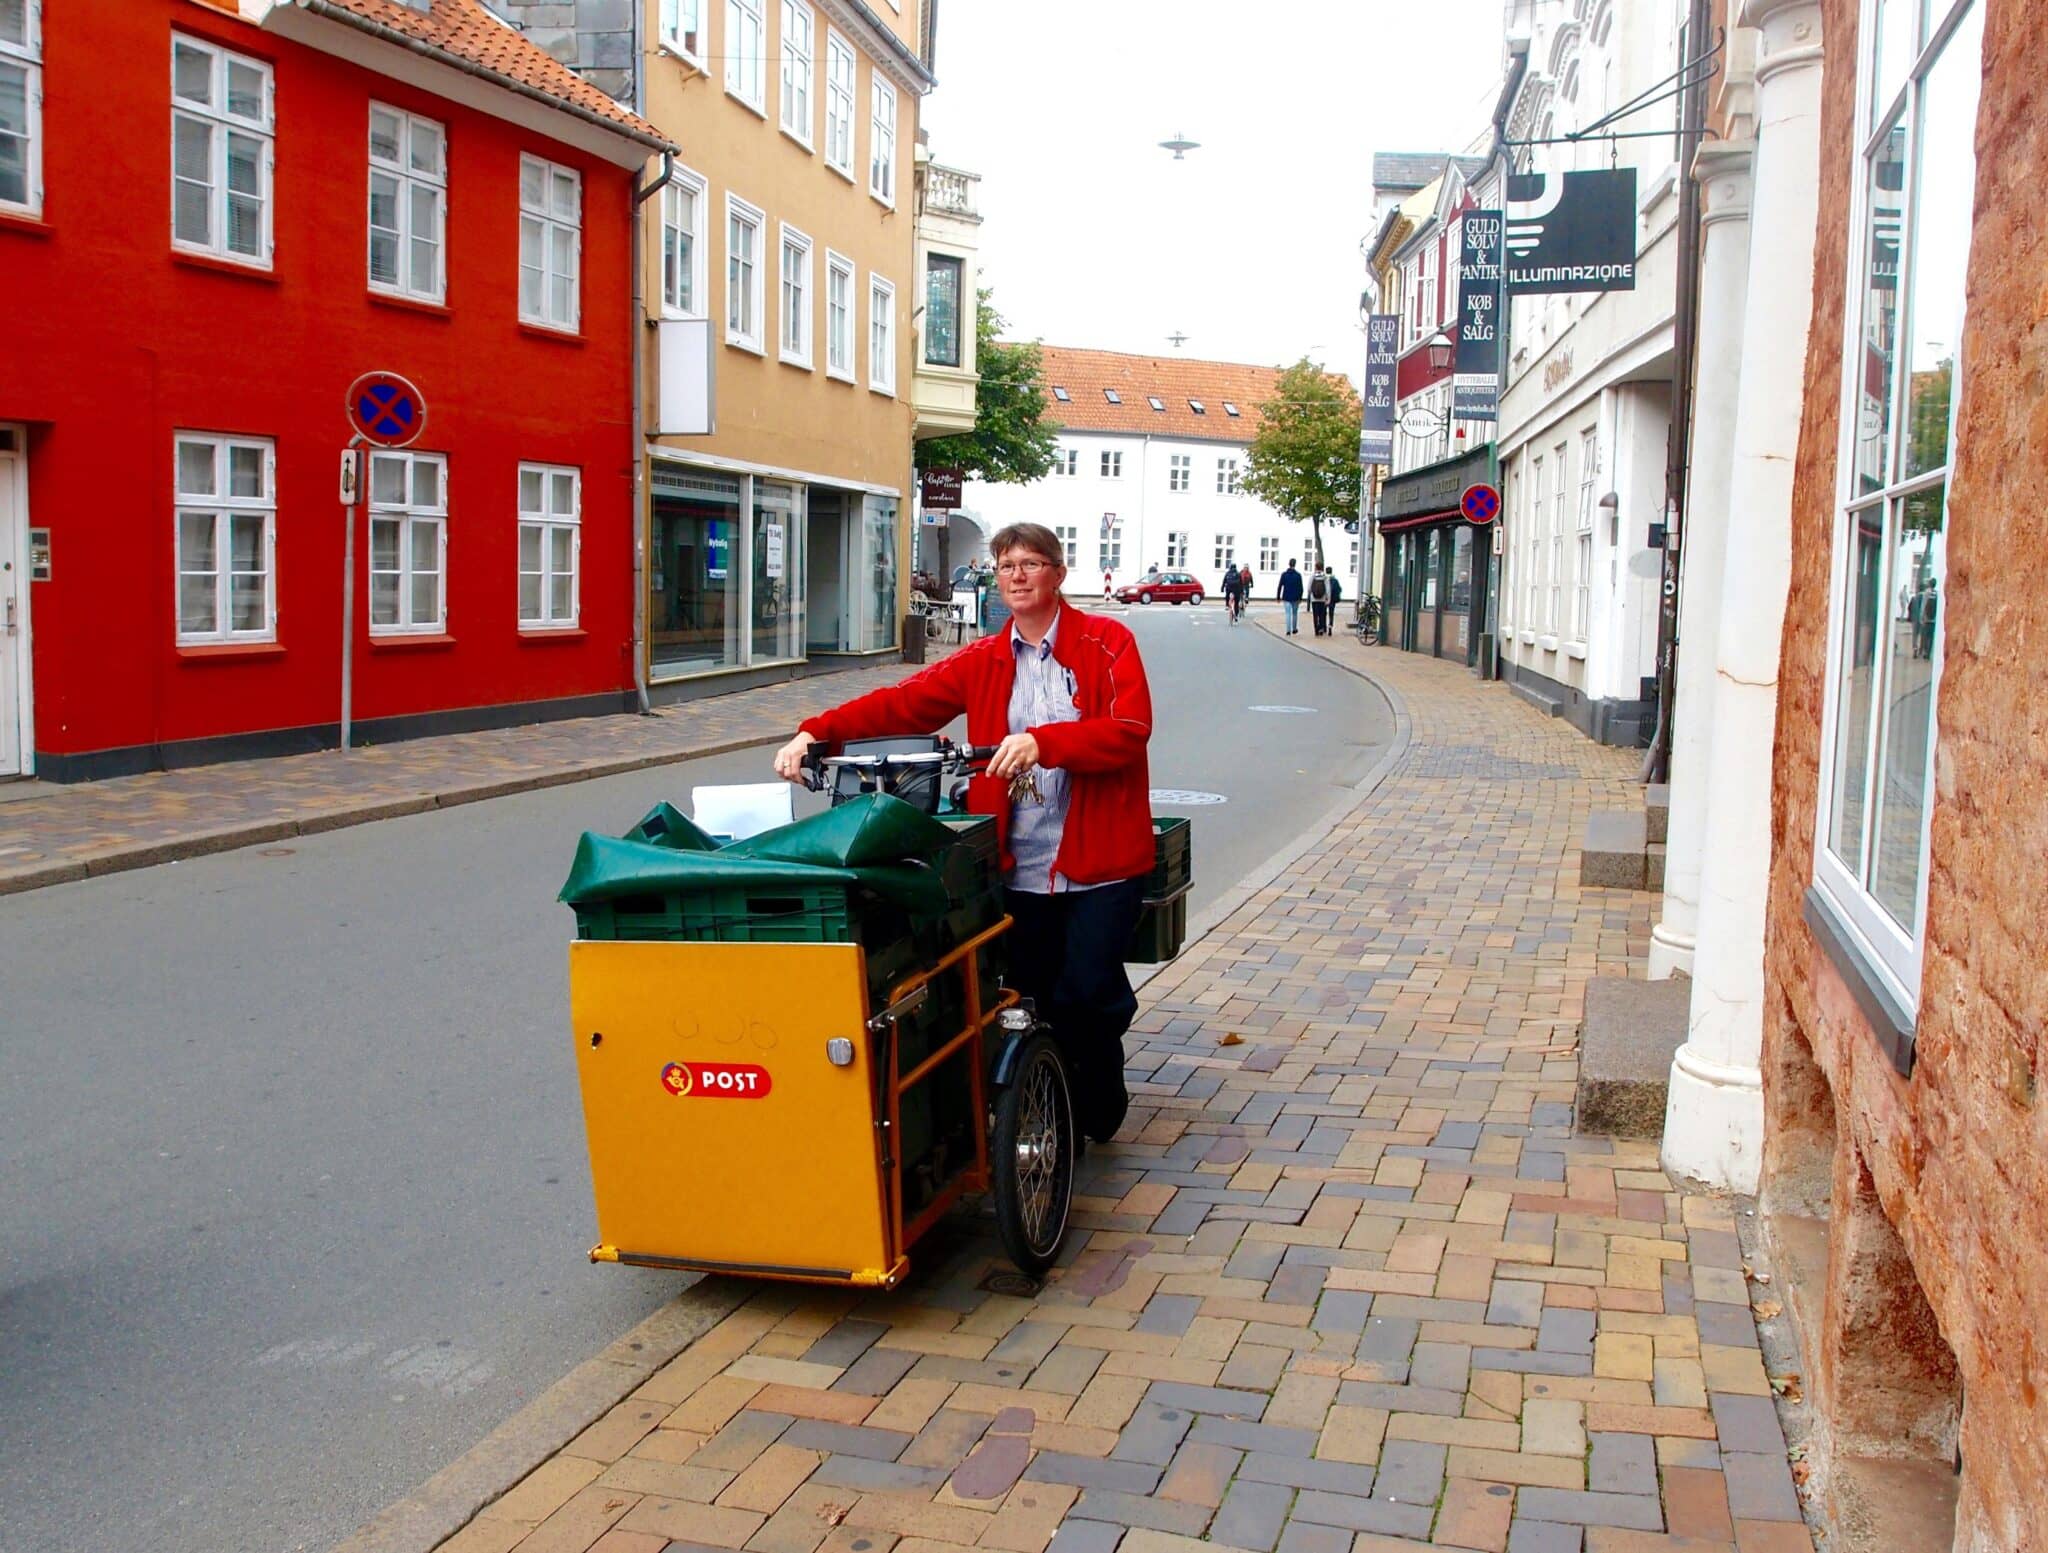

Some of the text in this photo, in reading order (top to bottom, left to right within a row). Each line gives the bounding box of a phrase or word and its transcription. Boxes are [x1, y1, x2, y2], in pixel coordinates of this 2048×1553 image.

[1466, 218, 1500, 234] GULD
[1466, 234, 1498, 249] SØLV
[1476, 249, 1486, 264] &
[1462, 265, 1500, 280] ANTIK
[1509, 263, 1633, 283] ILLUMINAZIONE
[1467, 294, 1492, 310] KØB
[1473, 310, 1484, 325] &
[1370, 320, 1395, 331] GULD
[1463, 325, 1494, 340] SALG
[1371, 331, 1394, 342] SØLV
[1368, 353, 1395, 364] ANTIK
[1371, 375, 1390, 386] KØB
[1368, 396, 1390, 407] SALG
[702, 1071, 758, 1092] POST
